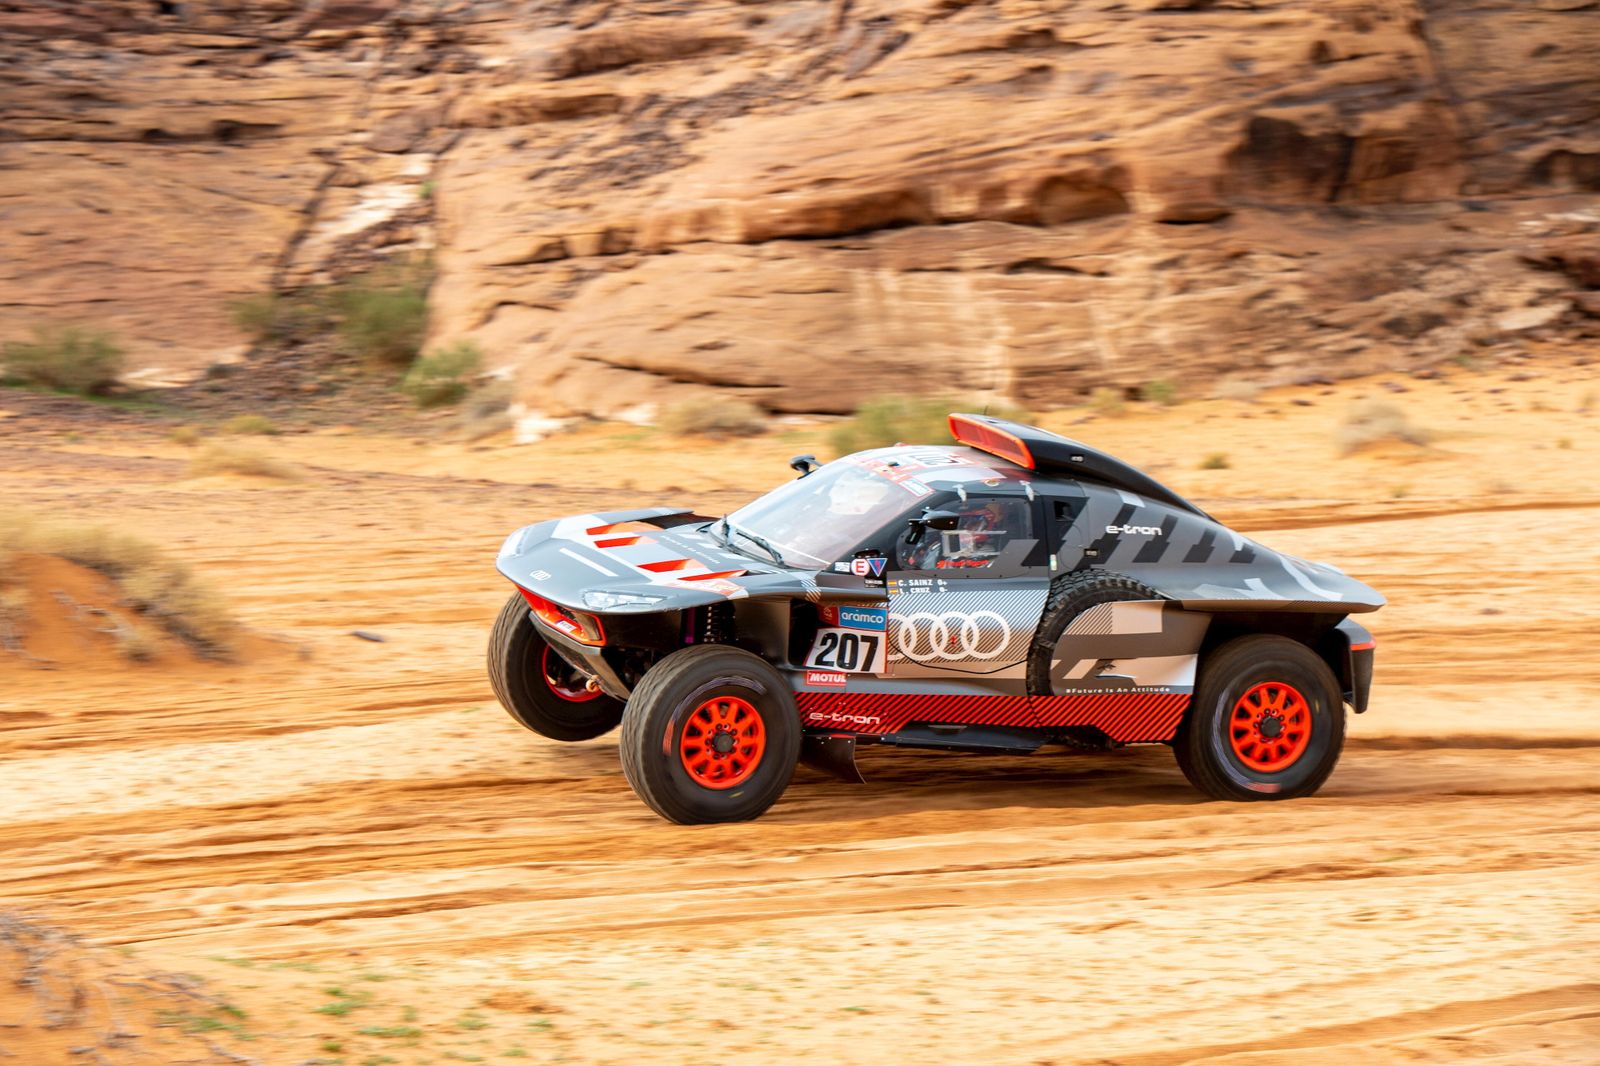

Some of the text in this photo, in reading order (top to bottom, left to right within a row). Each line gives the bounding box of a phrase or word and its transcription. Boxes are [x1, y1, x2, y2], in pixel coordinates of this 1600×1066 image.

[1105, 524, 1163, 536] e-tron
[855, 561, 865, 573] E
[841, 612, 884, 624] aramco
[814, 632, 879, 672] 207
[809, 673, 847, 683] MOTUL
[809, 711, 881, 725] e-tron
